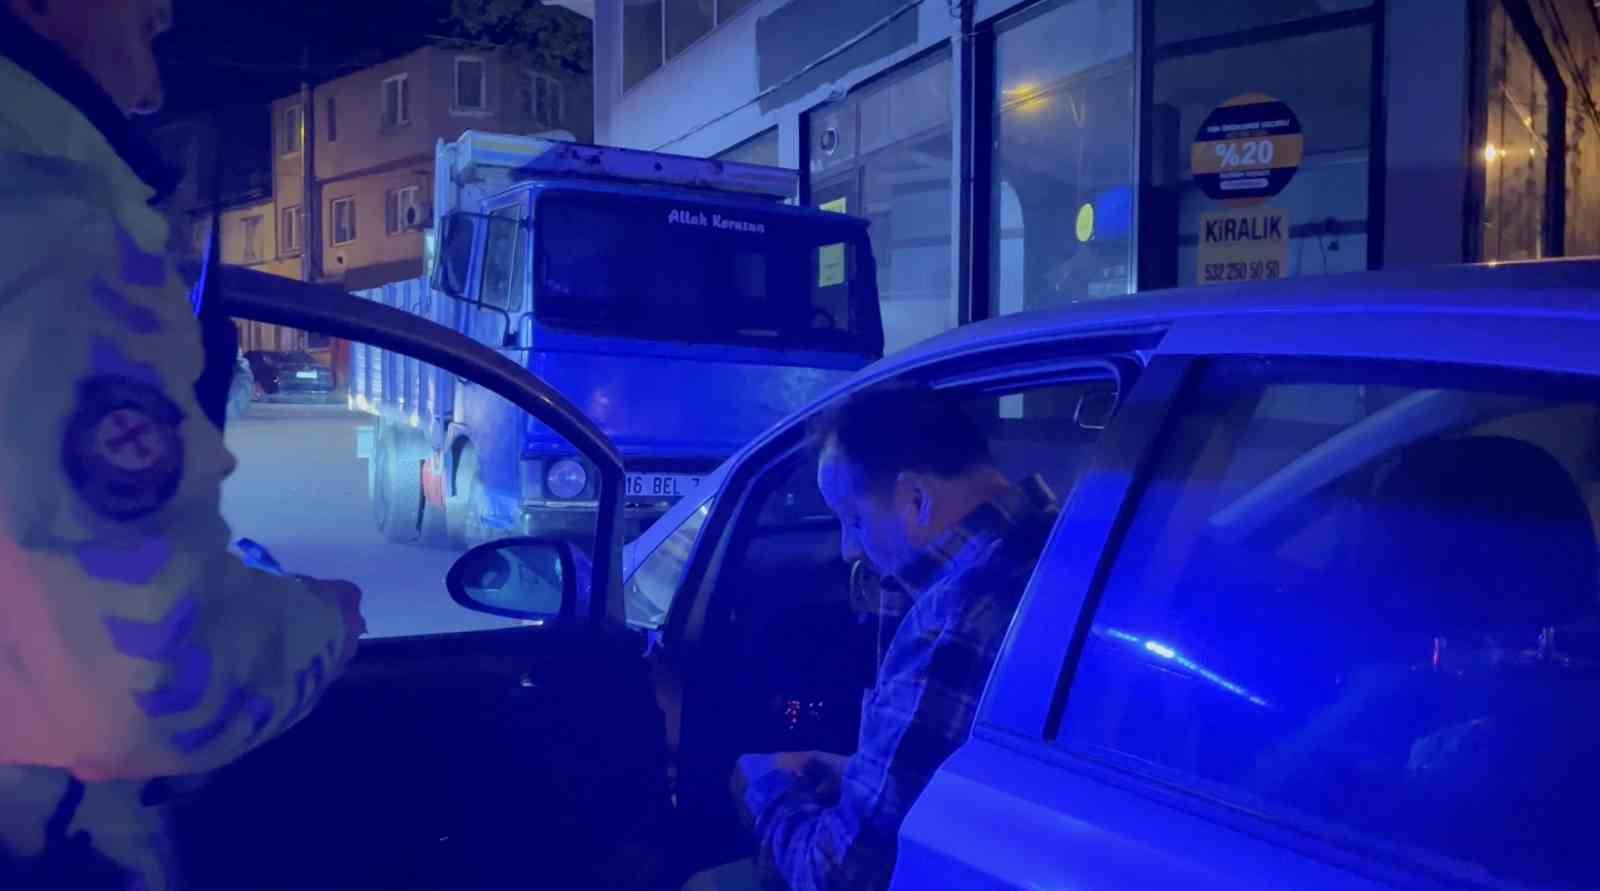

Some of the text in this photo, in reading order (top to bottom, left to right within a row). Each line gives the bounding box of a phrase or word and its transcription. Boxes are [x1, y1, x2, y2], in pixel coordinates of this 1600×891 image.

[1216, 140, 1274, 167] %20
[626, 476, 642, 494] 16
[653, 477, 681, 494] BEL
